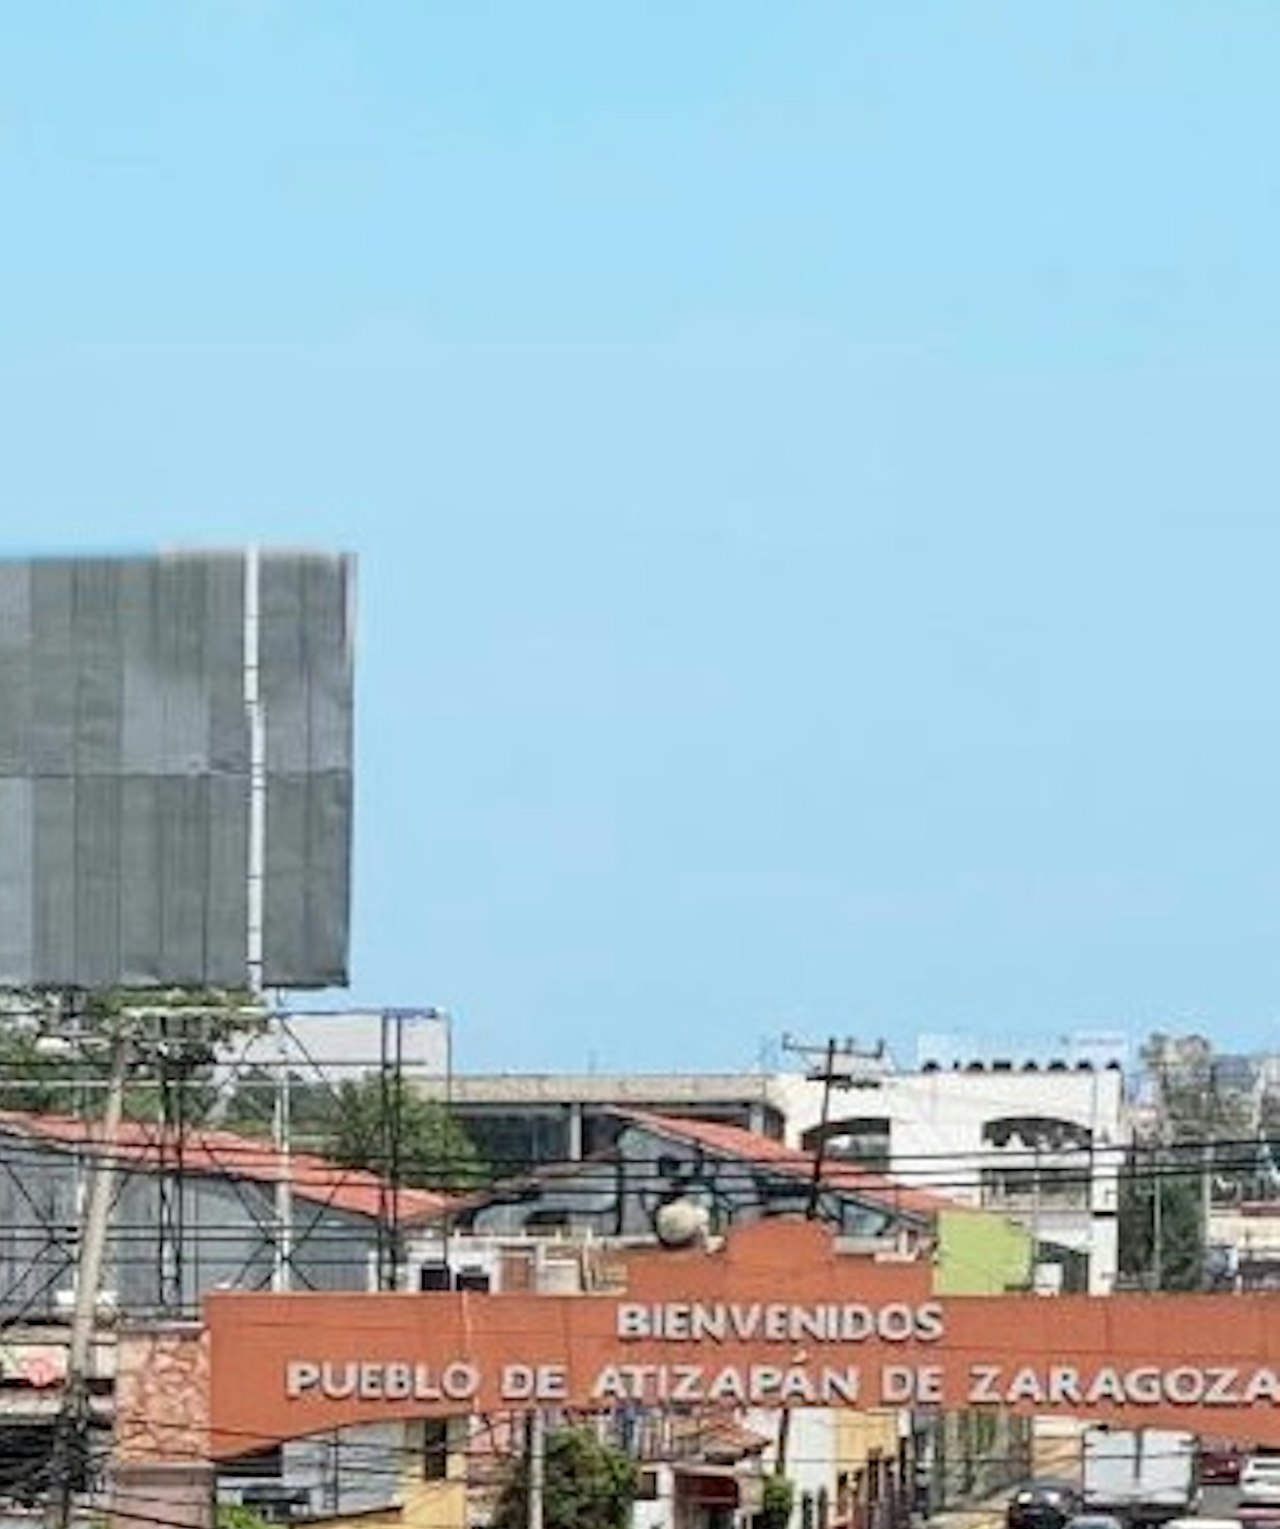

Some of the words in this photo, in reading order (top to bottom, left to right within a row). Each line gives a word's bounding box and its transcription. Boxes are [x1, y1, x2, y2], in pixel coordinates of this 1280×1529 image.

[616, 1302, 944, 1344] BIENVENIDOS
[286, 1362, 482, 1400] PUEBLO
[500, 1363, 568, 1400] DE
[591, 1351, 860, 1403] ATIZAPÁN
[881, 1365, 944, 1403] DE
[970, 1365, 1280, 1407] ZARAGOZA
